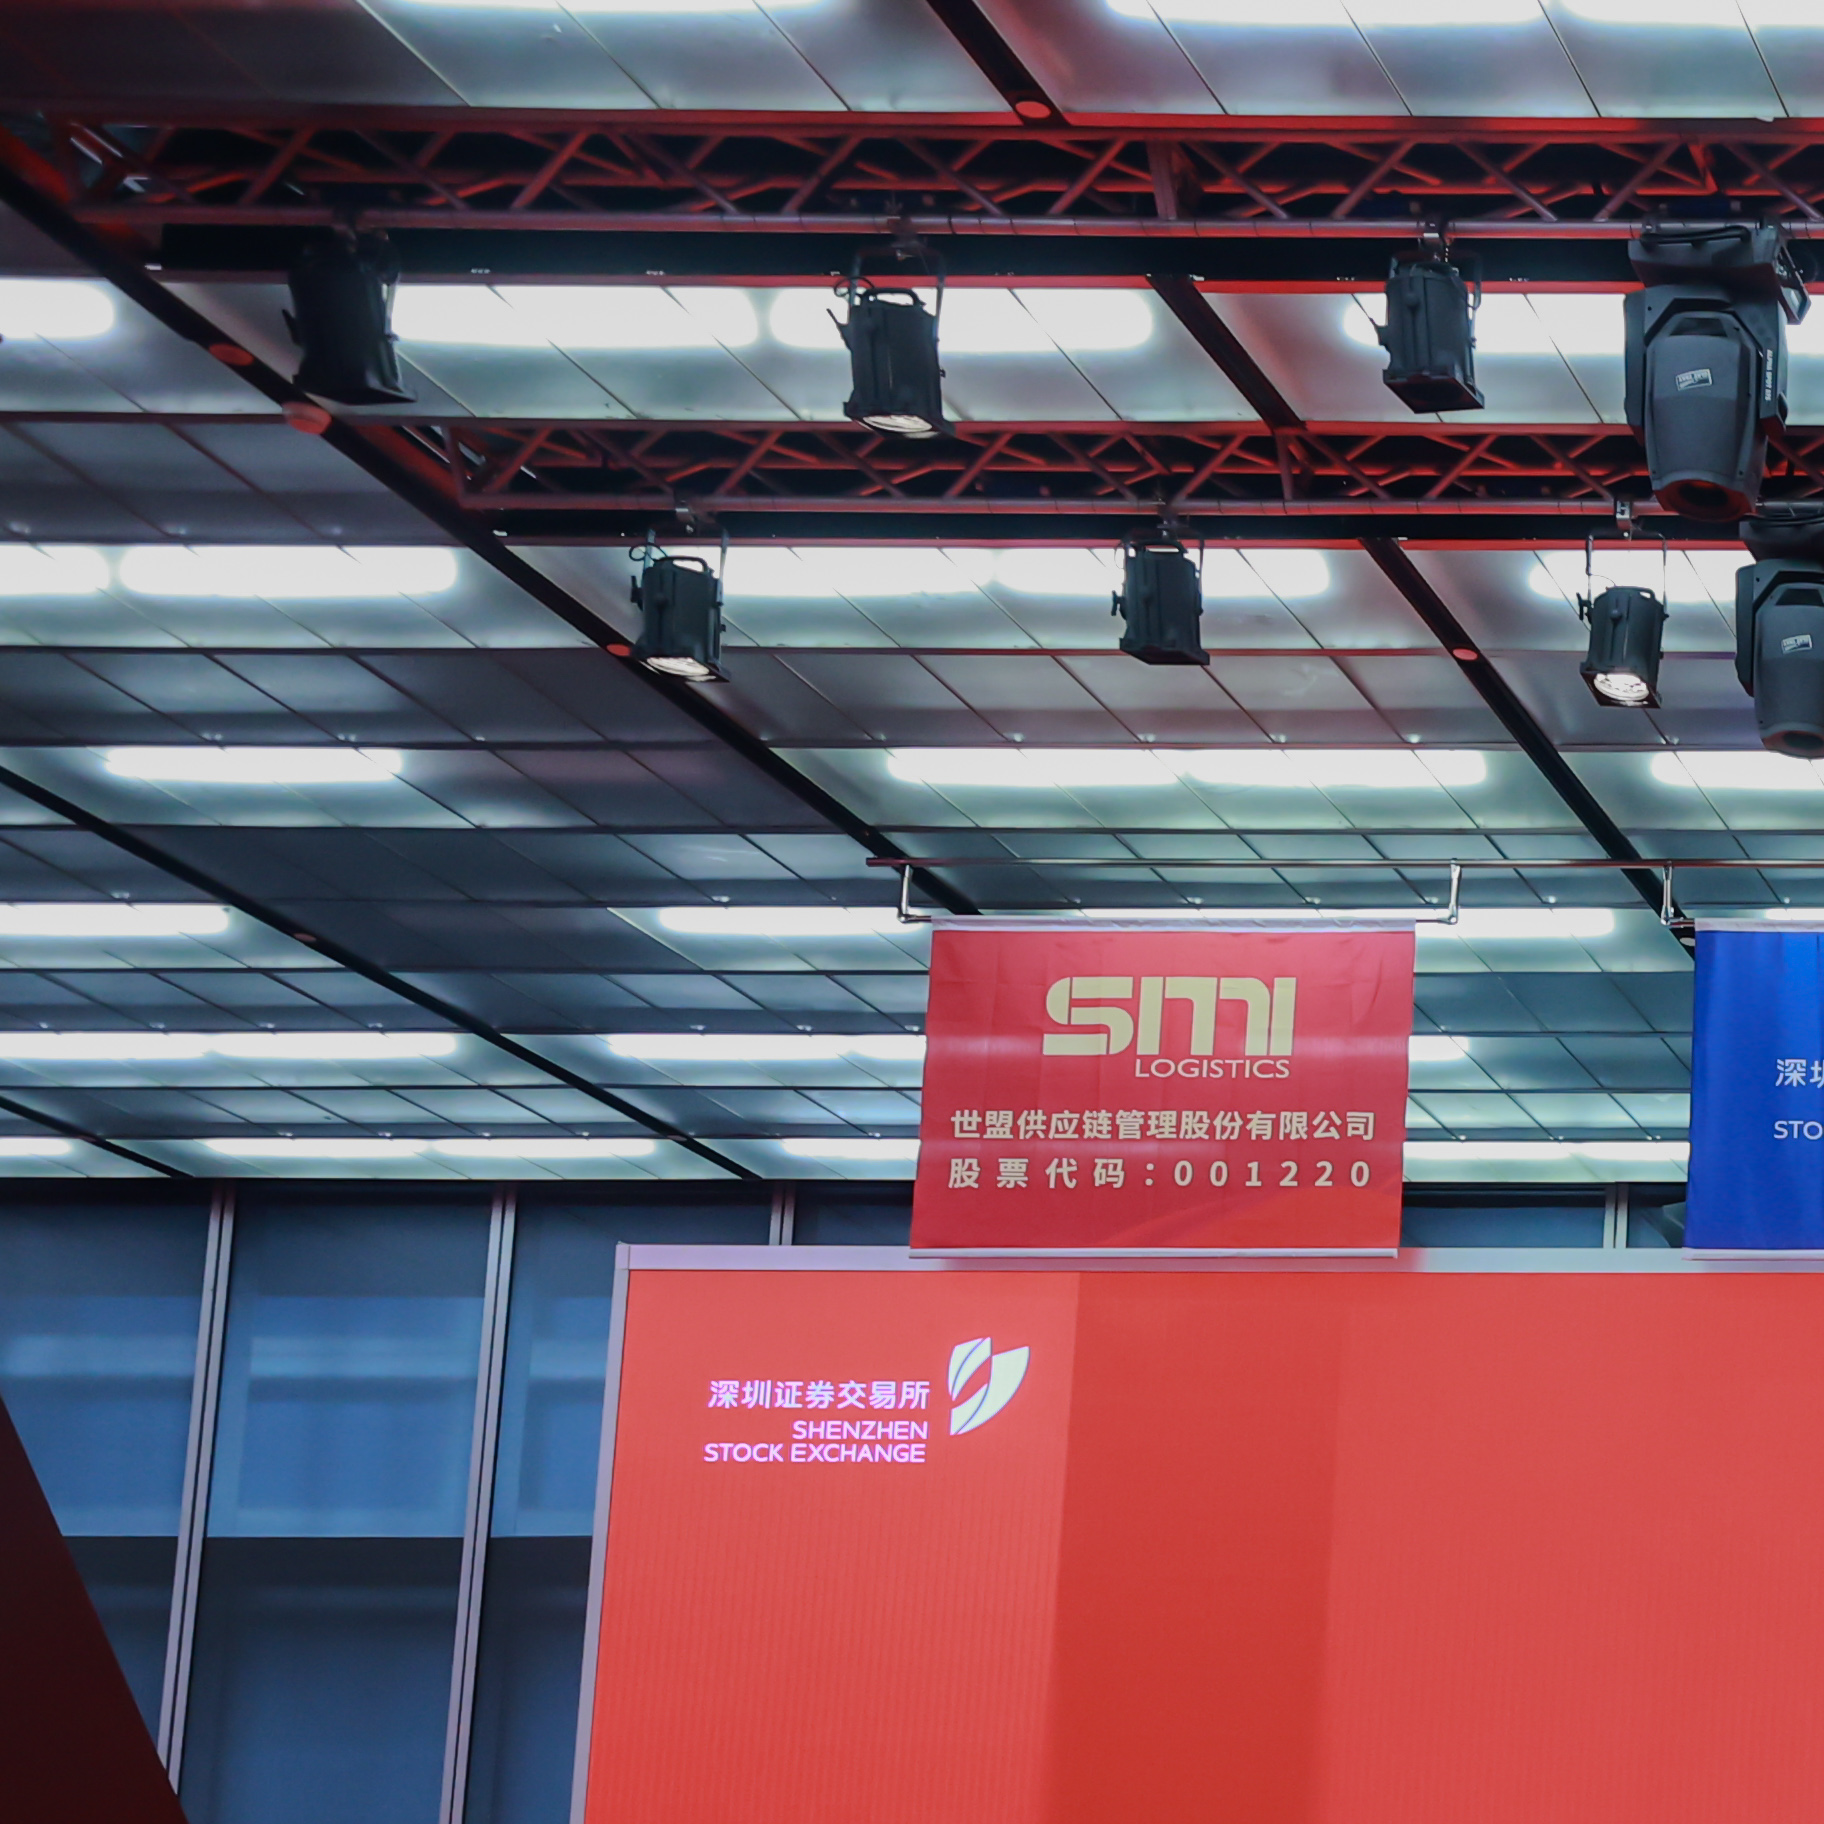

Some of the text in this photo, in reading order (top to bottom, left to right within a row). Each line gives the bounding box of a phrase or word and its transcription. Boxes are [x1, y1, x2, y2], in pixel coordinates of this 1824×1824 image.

[1135, 1058, 1290, 1079] LOGISTICS
[950, 1109, 1375, 1141] 世盟供应链管理股份有限公司
[707, 1379, 931, 1410] 深圳证券交易所
[792, 1420, 929, 1441] SHENZHEN
[703, 1442, 927, 1463] STOCK EXCHANGE
